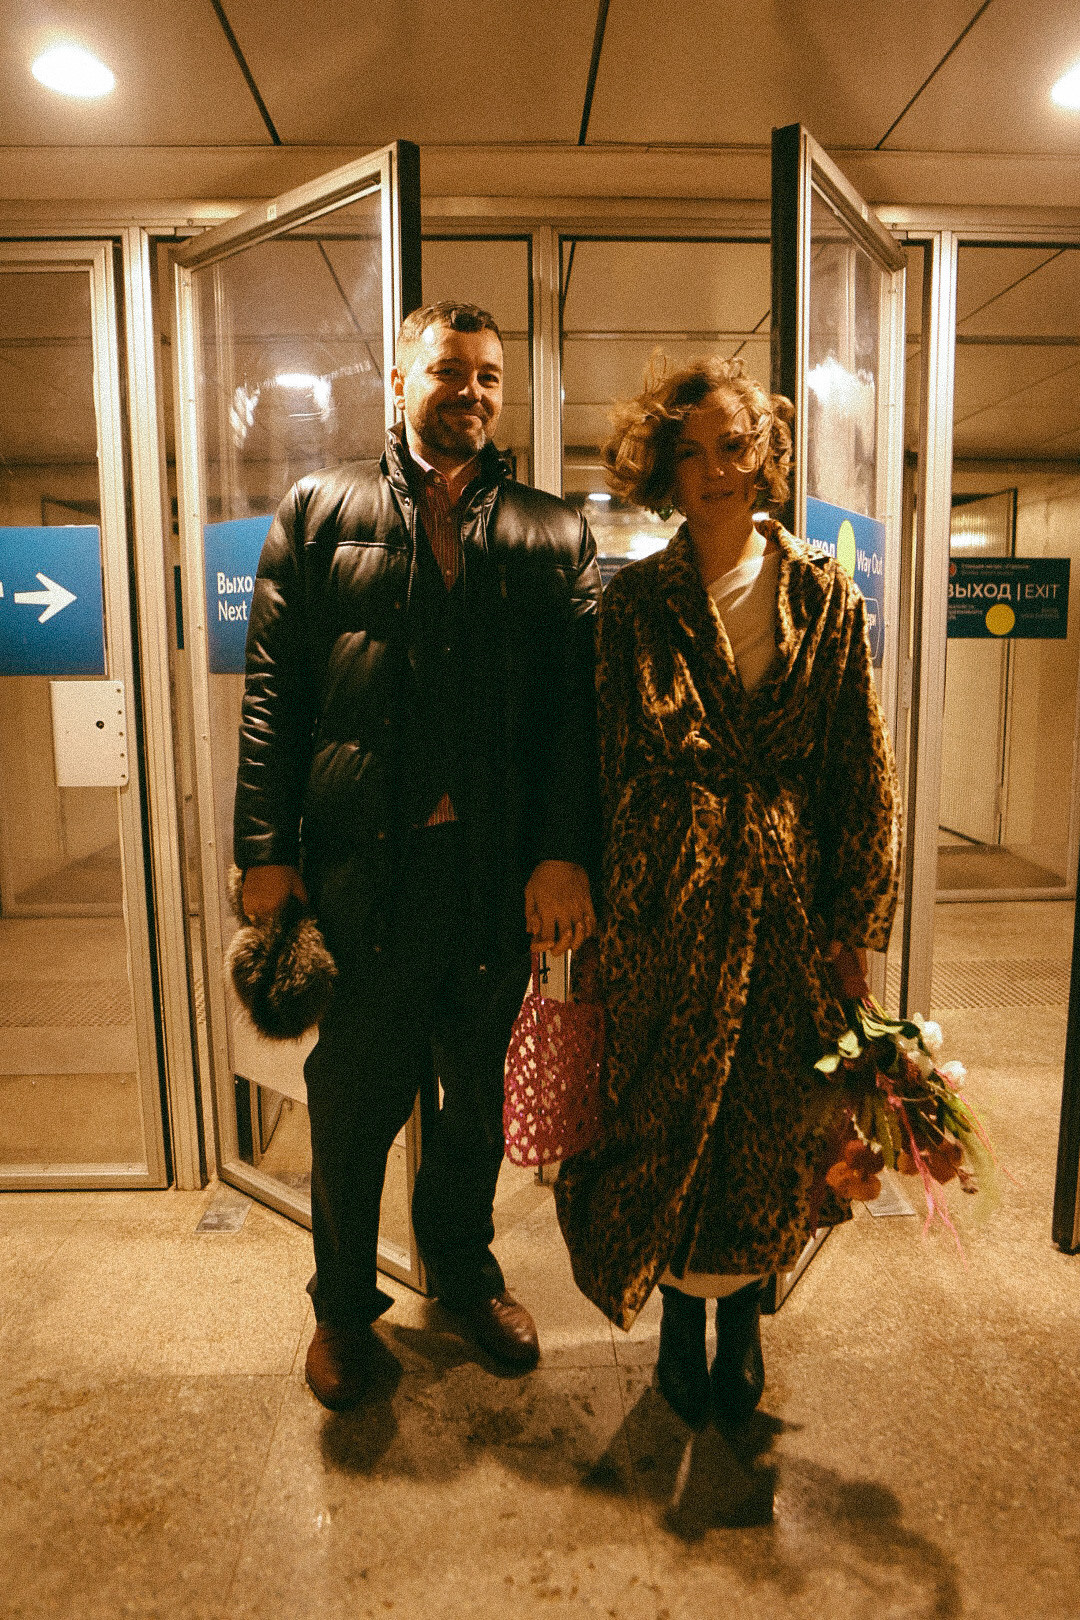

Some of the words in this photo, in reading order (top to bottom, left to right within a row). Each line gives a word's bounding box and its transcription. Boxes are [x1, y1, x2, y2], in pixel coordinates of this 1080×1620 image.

[856, 549, 871, 578] Way
[872, 552, 883, 576] Out
[217, 572, 255, 594] Выхо
[1025, 583, 1060, 599] EXIT
[218, 600, 248, 621] Next
